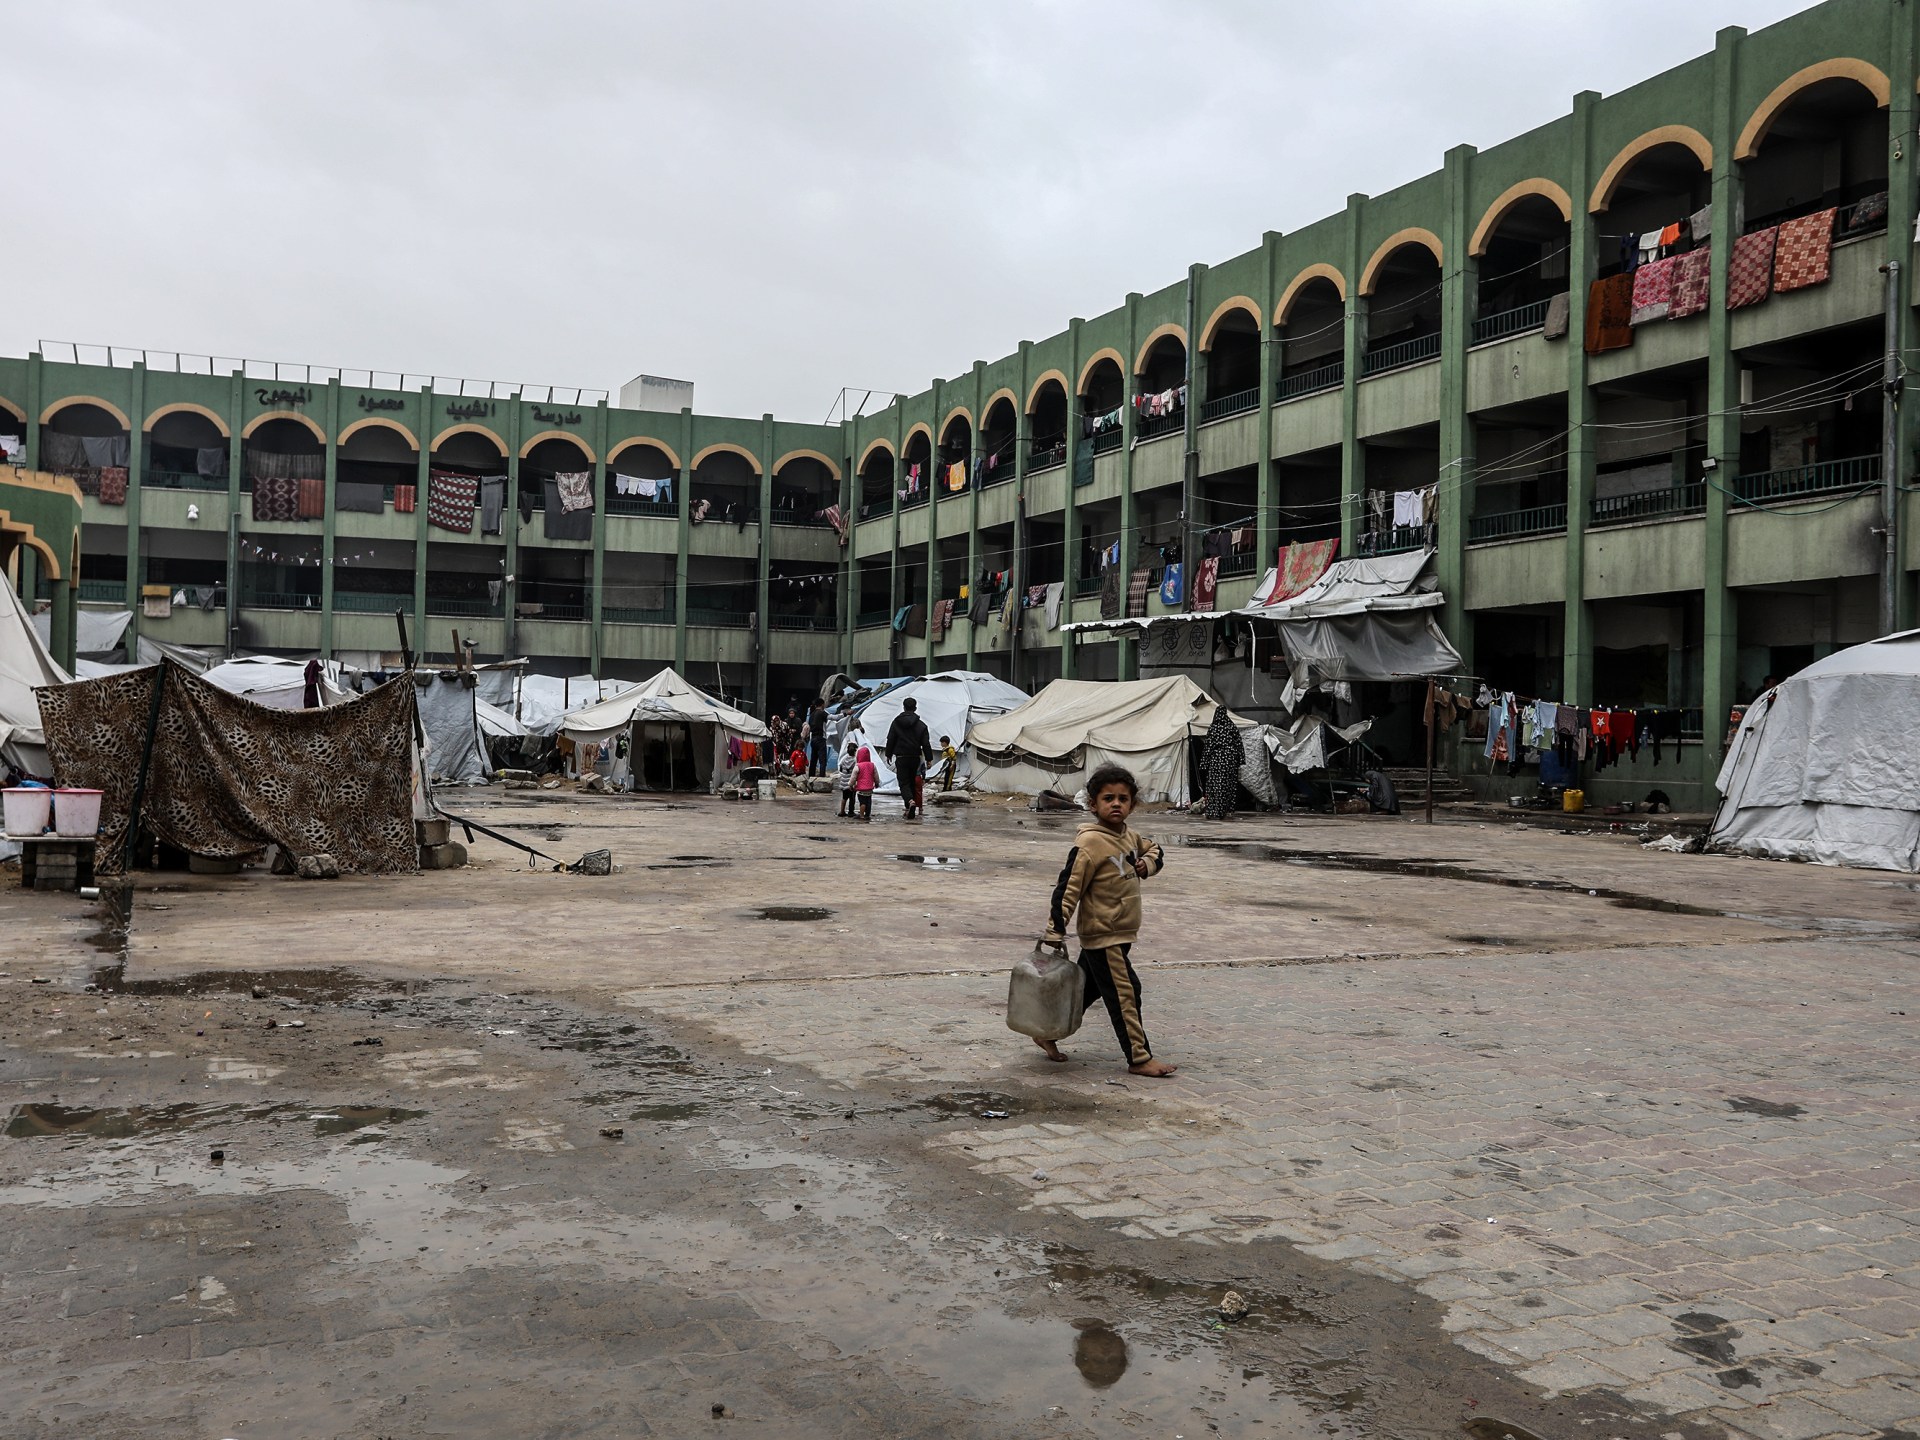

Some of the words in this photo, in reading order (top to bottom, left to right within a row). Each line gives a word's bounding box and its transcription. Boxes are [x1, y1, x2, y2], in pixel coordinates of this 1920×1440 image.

[358, 394, 405, 413] محمود
[446, 399, 496, 421] الشهيد
[531, 404, 582, 426] مدرسة
